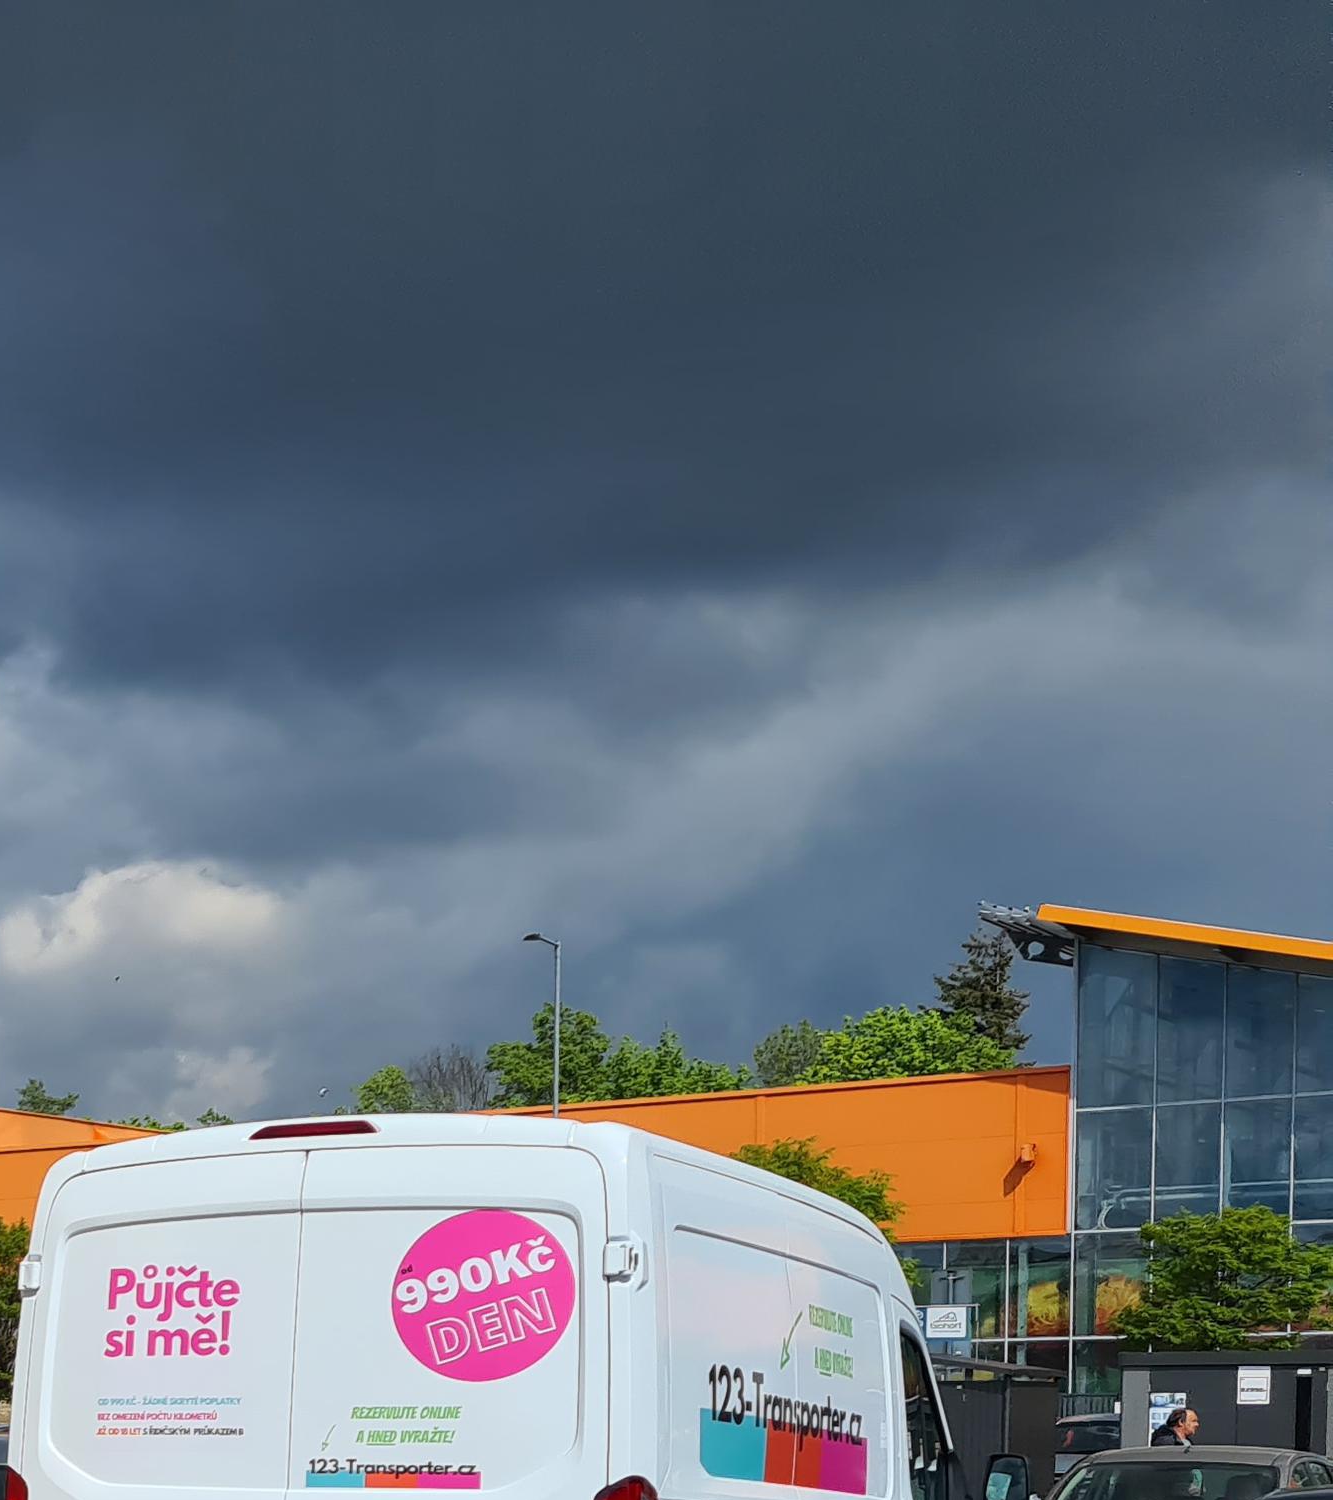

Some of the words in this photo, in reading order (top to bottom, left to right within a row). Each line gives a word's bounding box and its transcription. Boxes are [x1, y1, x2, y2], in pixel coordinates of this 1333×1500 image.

[108, 1264, 240, 1322] Půjčte
[395, 1235, 556, 1314] 990Kč
[104, 1315, 136, 1357] si
[147, 1310, 231, 1357] mě!
[427, 1287, 557, 1365] DEN
[350, 1406, 418, 1419] REZERVUJTE
[420, 1406, 462, 1419] ONLINE
[708, 1363, 863, 1452] 123-Transporter.cz
[356, 1430, 364, 1443] A
[367, 1430, 397, 1444] HNED
[399, 1427, 456, 1444] VYRAŽTE!
[308, 1458, 477, 1479] 123-Transporter.cz
